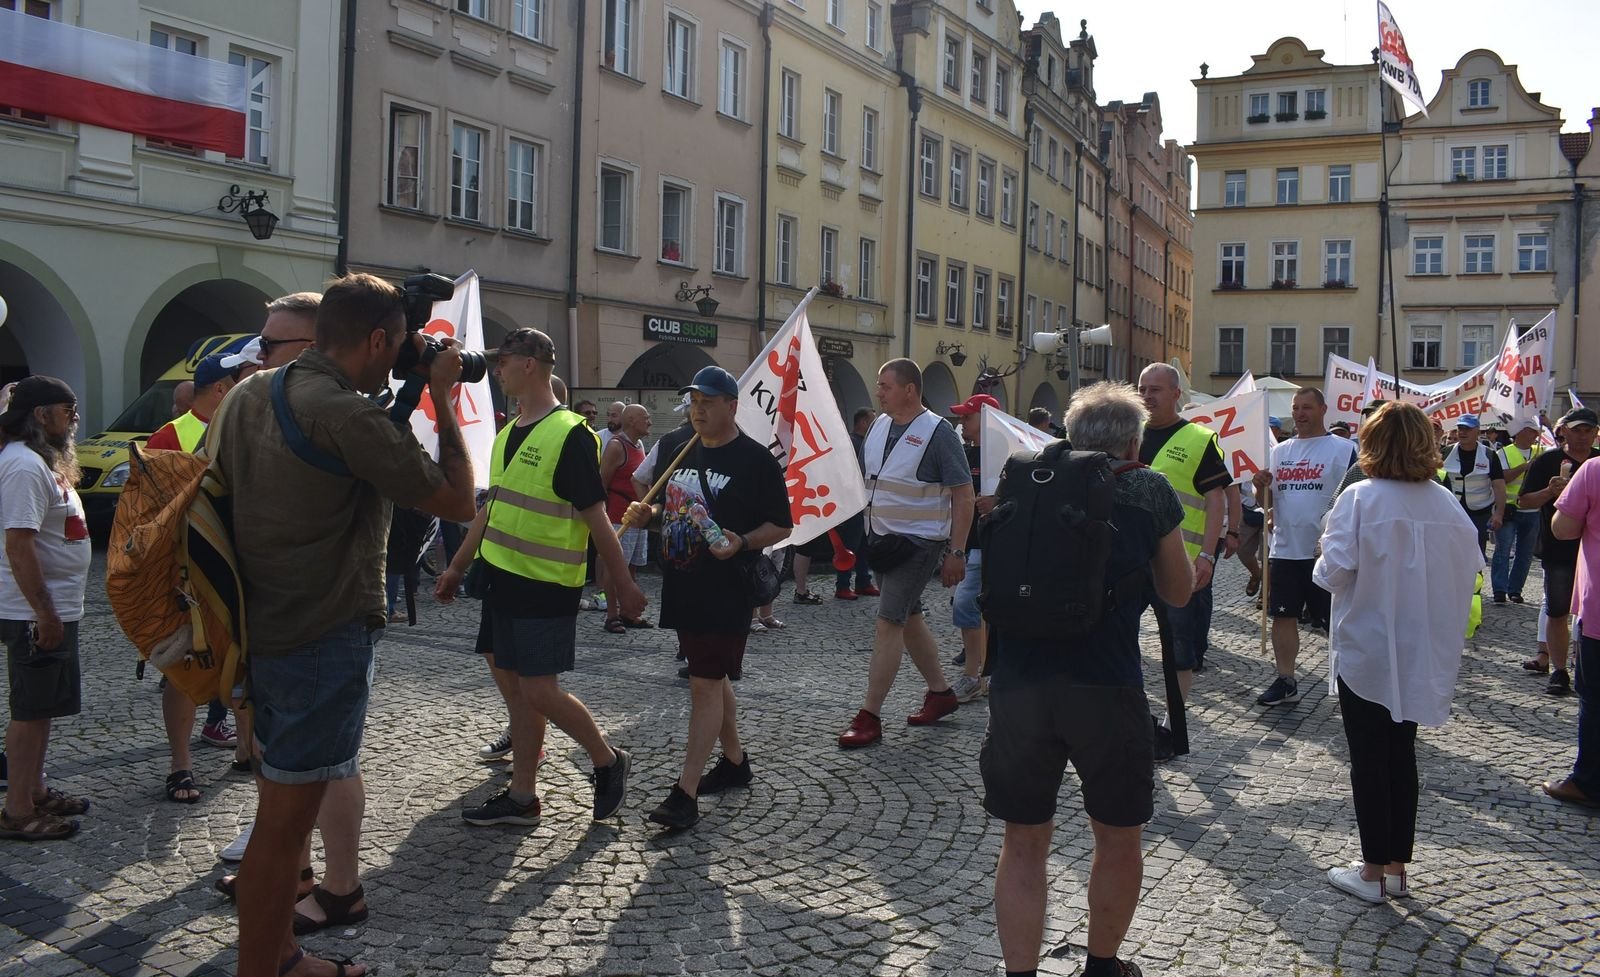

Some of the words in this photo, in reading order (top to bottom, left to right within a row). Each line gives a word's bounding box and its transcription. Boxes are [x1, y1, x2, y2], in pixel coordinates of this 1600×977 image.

[648, 318, 680, 334] CLUB
[682, 322, 716, 338] SUSHI
[520, 451, 534, 459] PRECZ
[1289, 482, 1323, 491] TURÓW
